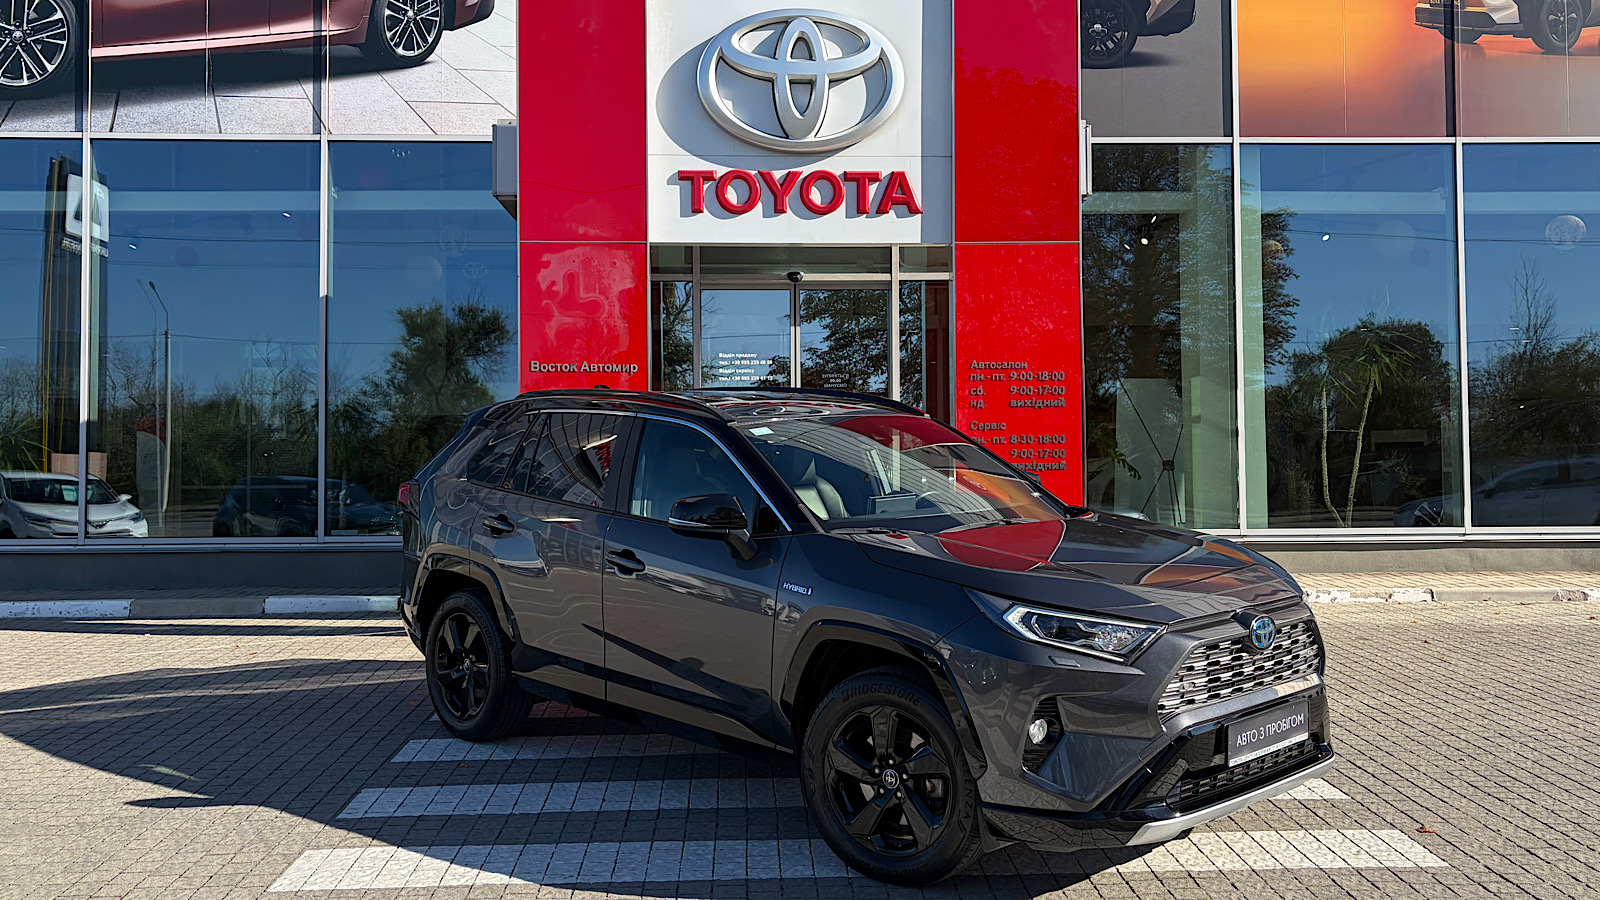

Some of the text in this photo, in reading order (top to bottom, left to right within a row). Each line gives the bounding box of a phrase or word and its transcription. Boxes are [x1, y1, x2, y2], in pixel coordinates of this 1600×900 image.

[678, 169, 923, 215] TOYOTA
[530, 360, 638, 375] Восток Автомир
[970, 360, 1028, 369] Автосалон
[970, 385, 987, 395] сб.
[970, 397, 1066, 409] нд. вихідний
[970, 420, 1007, 432] Сервіс
[782, 581, 808, 595] HYBRID
[841, 682, 922, 707] BRIDGESTONE
[1236, 712, 1304, 748] АВТО З ПРОБІГОМ
